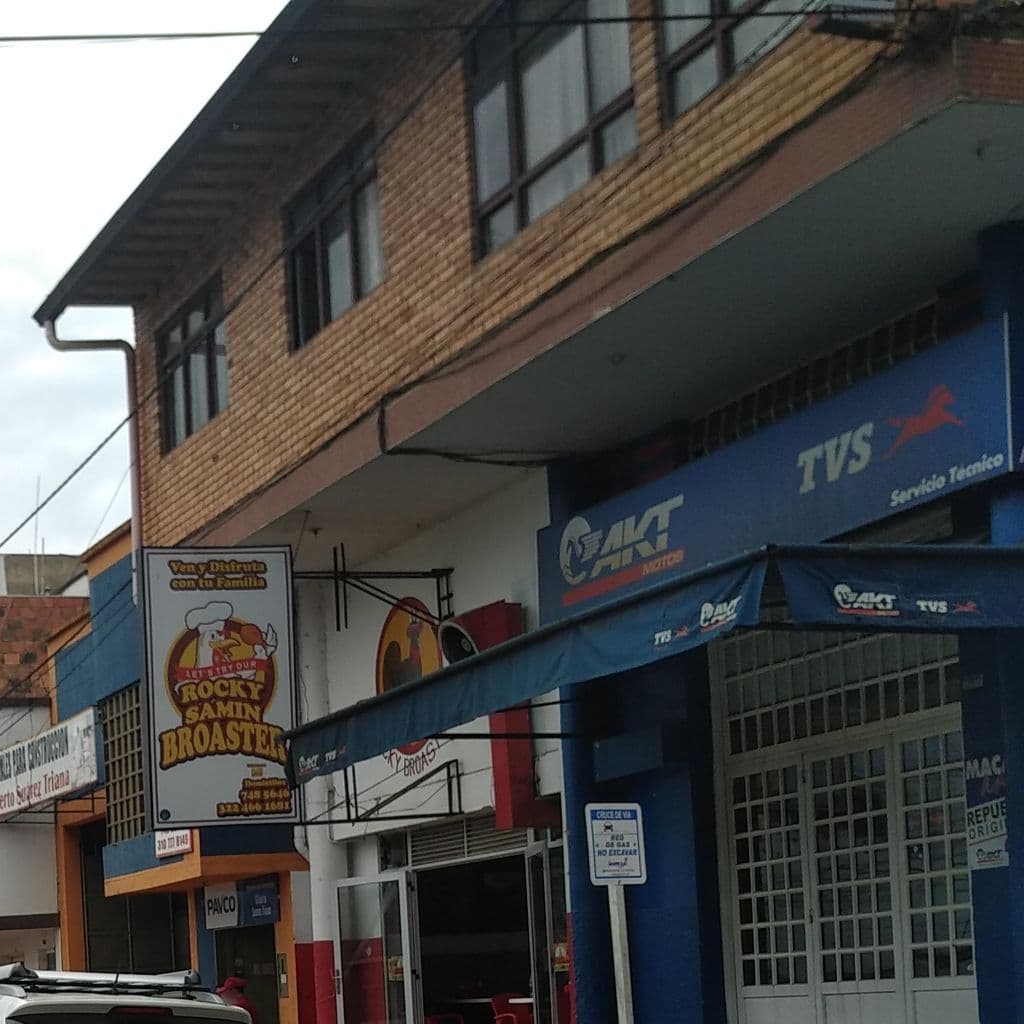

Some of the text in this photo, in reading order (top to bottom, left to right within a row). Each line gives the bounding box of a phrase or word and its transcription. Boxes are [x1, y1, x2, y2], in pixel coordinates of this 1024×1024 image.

[798, 421, 874, 495] TVS
[889, 474, 946, 507] Servicio
[590, 494, 685, 578] AKT
[169, 560, 265, 577] Ven y Disfruta
[171, 576, 265, 589] con tu Familia
[855, 590, 897, 611] AKT
[916, 599, 948, 614] TVS
[654, 629, 673, 646] TVS
[236, 659, 257, 671] OUR
[181, 679, 264, 703] ROCKY
[185, 701, 261, 723] SAMIN
[43, 769, 70, 795] Triana
[597, 849, 607, 857] NO
[207, 896, 236, 915] PAVCO
